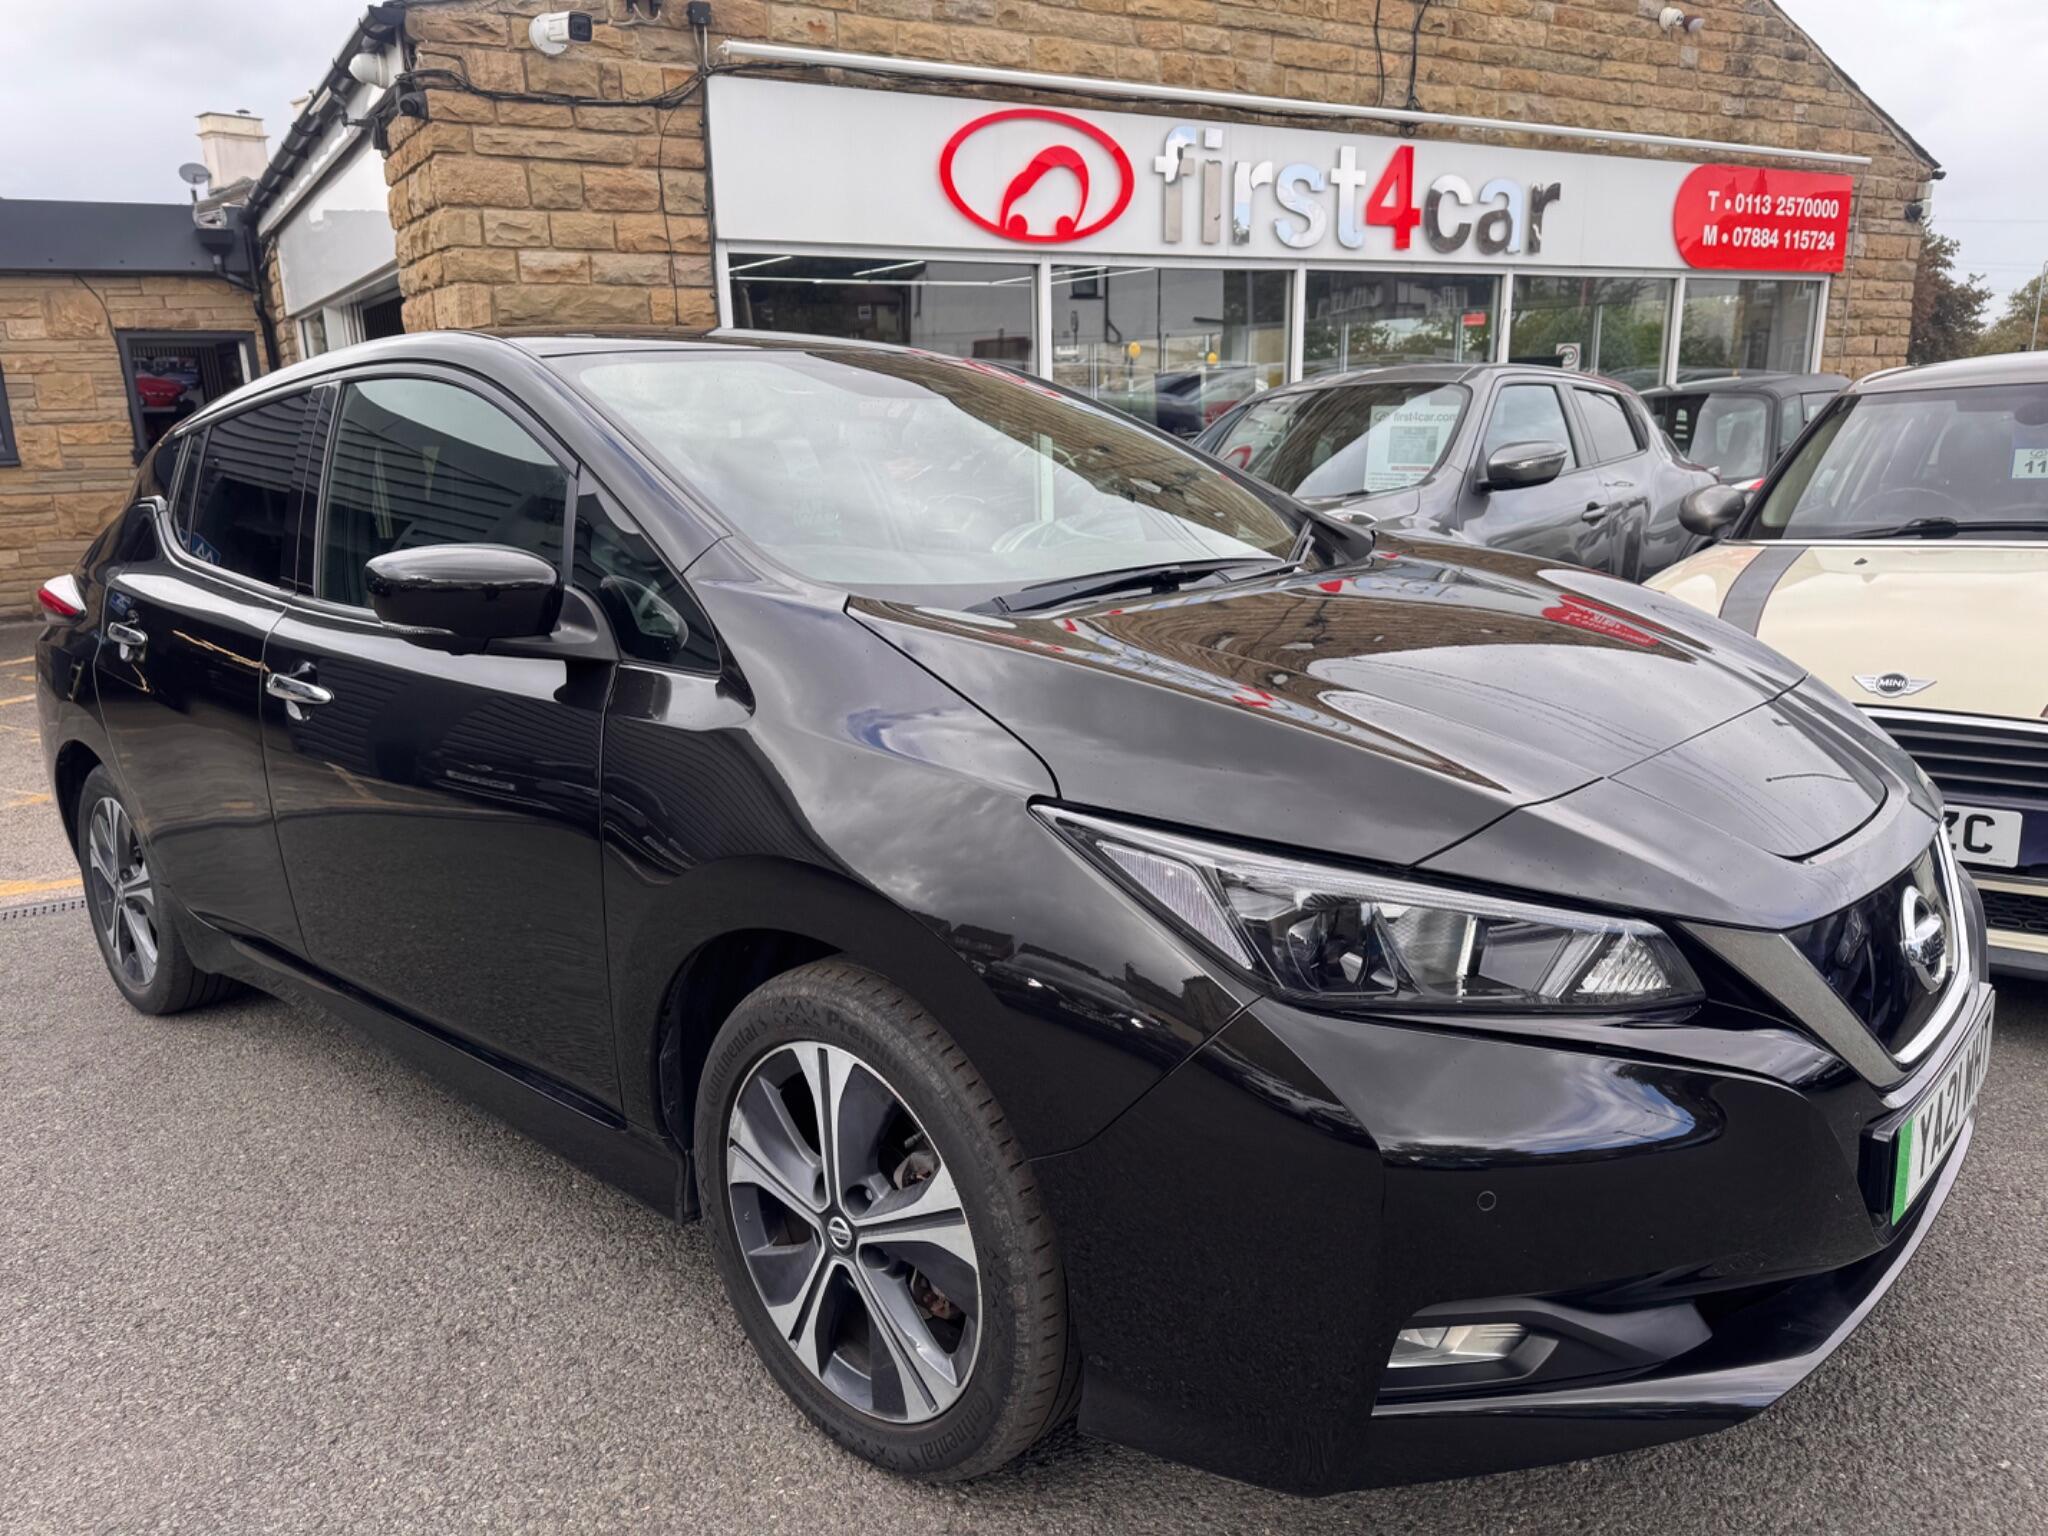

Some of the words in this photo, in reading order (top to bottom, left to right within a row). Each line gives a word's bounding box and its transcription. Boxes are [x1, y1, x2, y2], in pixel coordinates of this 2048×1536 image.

[1154, 126, 1561, 255] first4car
[1707, 190, 1720, 212] T
[1734, 193, 1772, 215] 0113
[1775, 197, 1840, 219] 2570000
[1702, 225, 1718, 246] M
[1732, 226, 1780, 248] 07884
[1784, 229, 1836, 250] 115724
[1879, 678, 1906, 688] MINI
